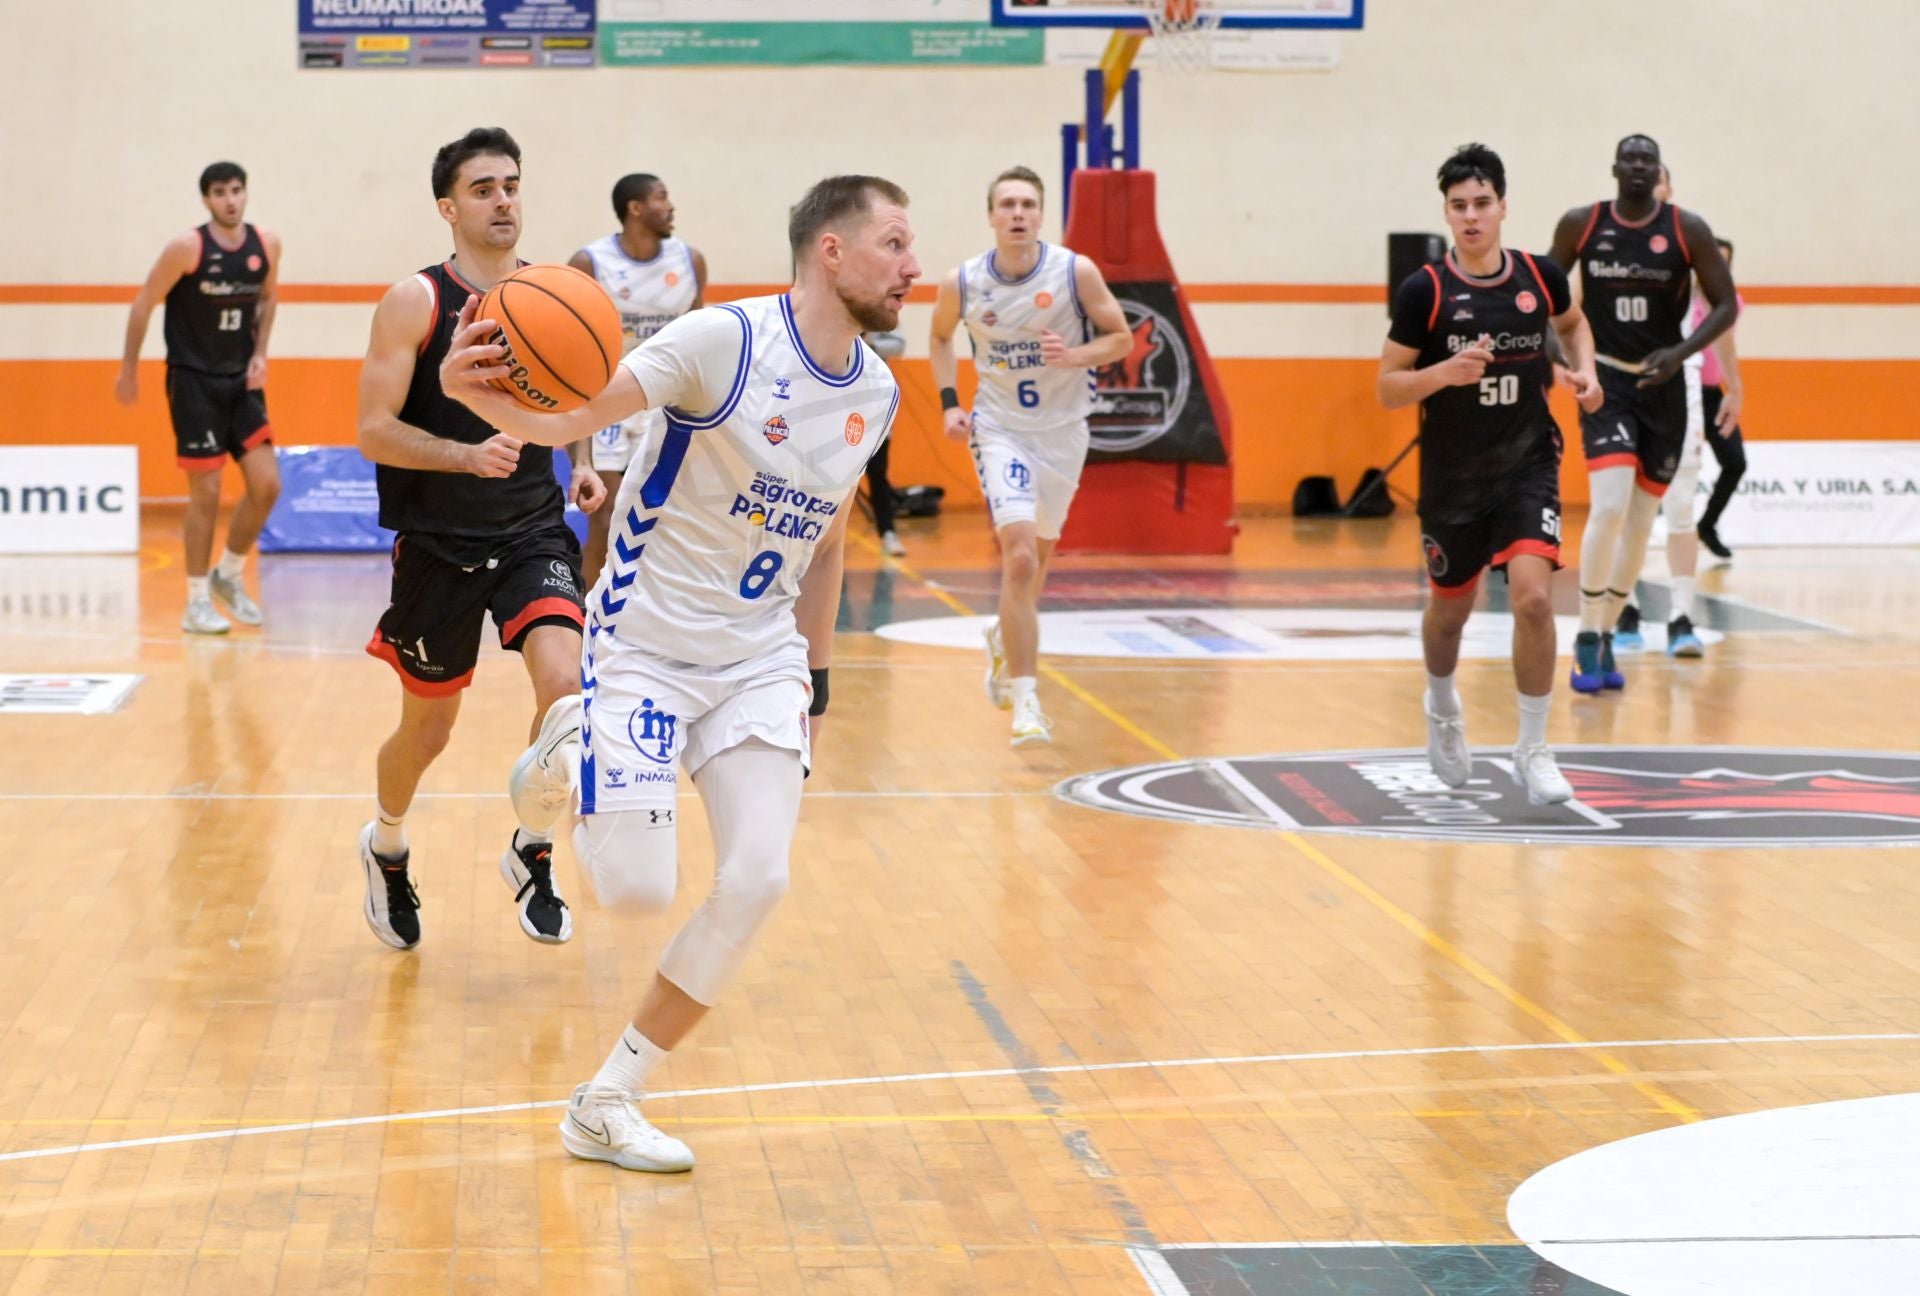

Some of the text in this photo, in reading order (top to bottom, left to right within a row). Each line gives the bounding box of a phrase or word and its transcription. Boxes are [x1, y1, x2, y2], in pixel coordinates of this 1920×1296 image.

[312, 0, 487, 15] NEUMATIKOAK
[219, 309, 243, 331] 13
[1615, 296, 1648, 322] 00
[1017, 380, 1040, 408] 6
[1479, 374, 1519, 406] 50
[1794, 479, 1808, 495] Y
[1816, 479, 1873, 496] URIA
[739, 550, 783, 600] 8
